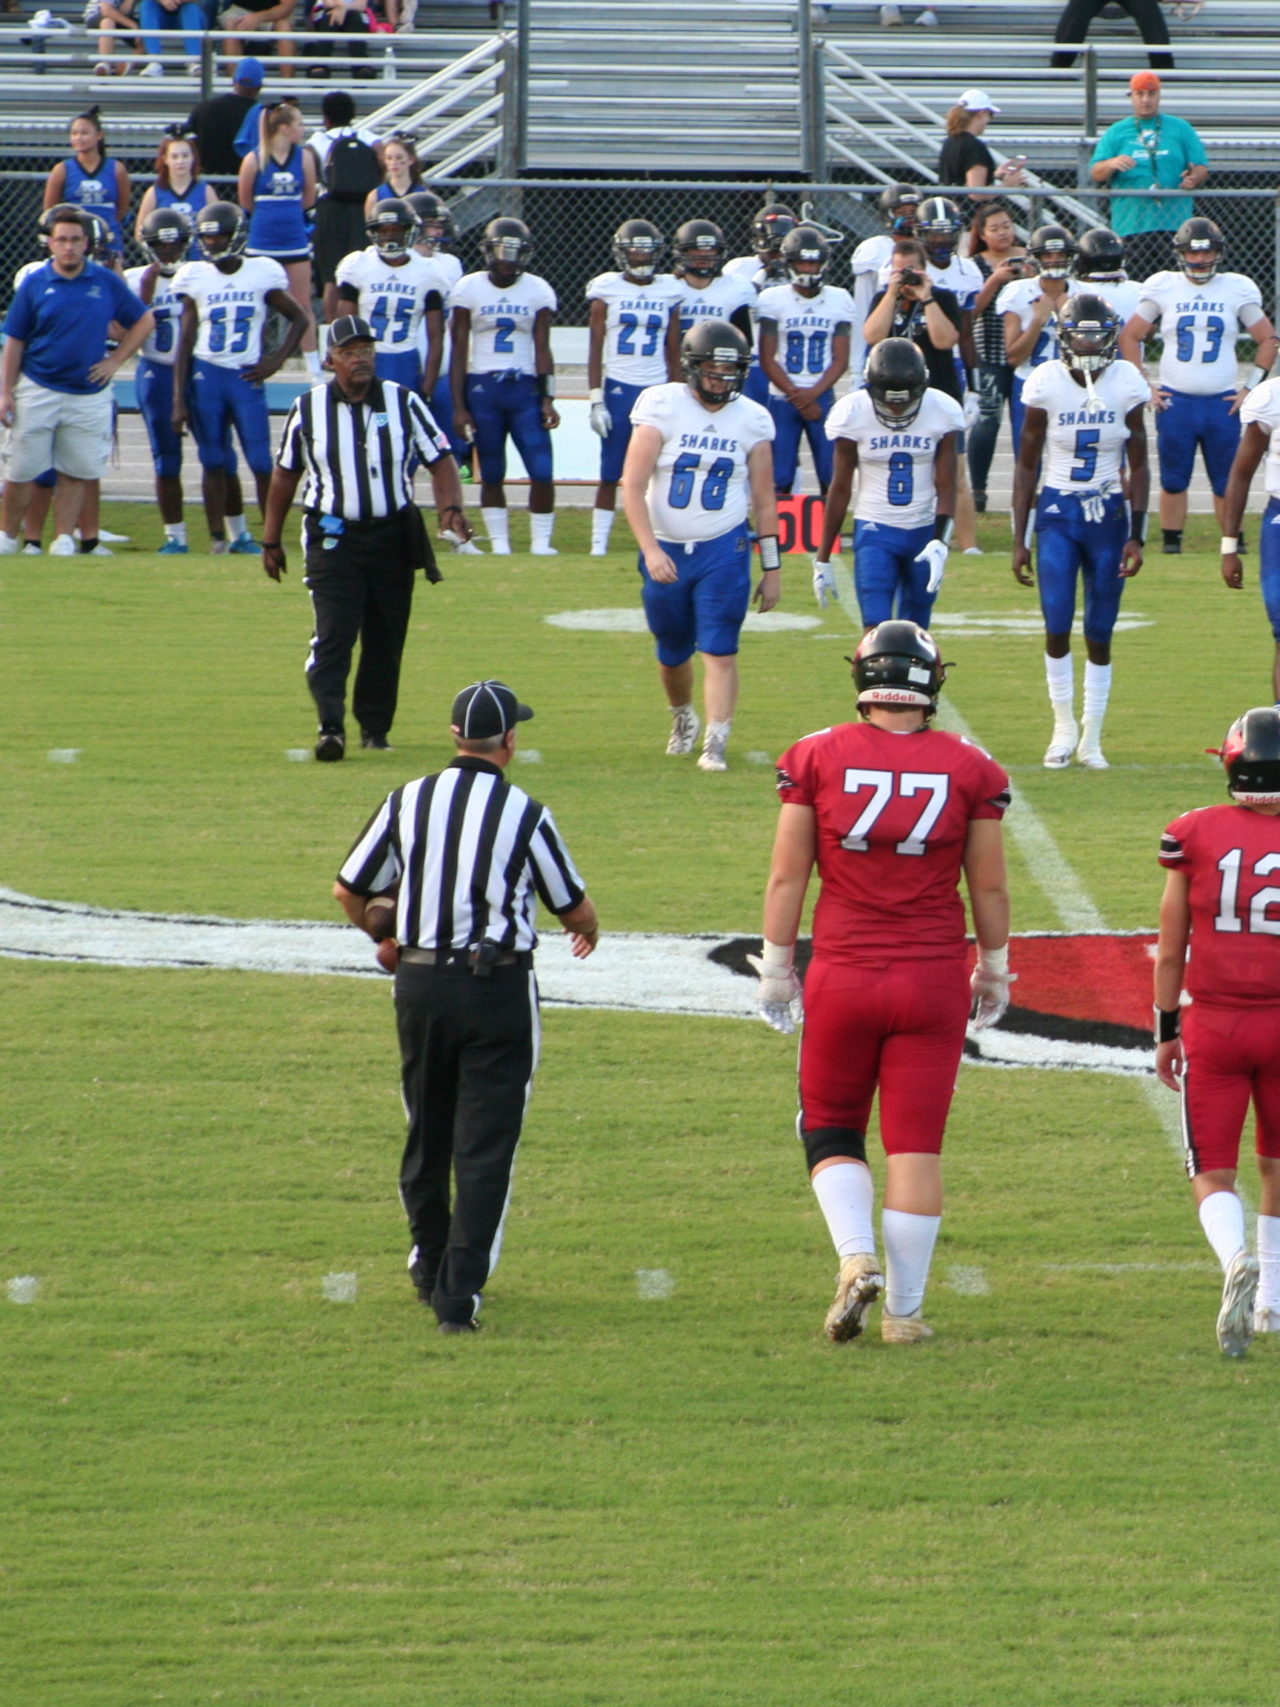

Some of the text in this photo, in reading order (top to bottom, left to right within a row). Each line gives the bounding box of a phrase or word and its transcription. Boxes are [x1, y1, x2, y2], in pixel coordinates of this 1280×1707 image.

[207, 291, 254, 305] SHARKS
[370, 283, 417, 296] SHARKS
[480, 304, 530, 316] SHARKS
[619, 300, 664, 312] SHARKS
[681, 304, 723, 317] HARKS
[1176, 302, 1224, 313] SHARKS
[208, 306, 255, 353] 65
[370, 295, 416, 344] 45
[786, 317, 831, 329] SHARKS
[494, 317, 517, 353] 2
[617, 312, 662, 357] 23
[1176, 315, 1225, 364] 63
[786, 331, 828, 374] 80
[1058, 411, 1116, 426] SHARKS
[679, 433, 738, 453] SHARKS
[870, 435, 932, 450] SHARKS
[1070, 428, 1101, 482] 5
[668, 452, 735, 511] 68
[887, 451, 914, 507] 8
[871, 691, 916, 702] Riddell
[841, 767, 950, 857] 77
